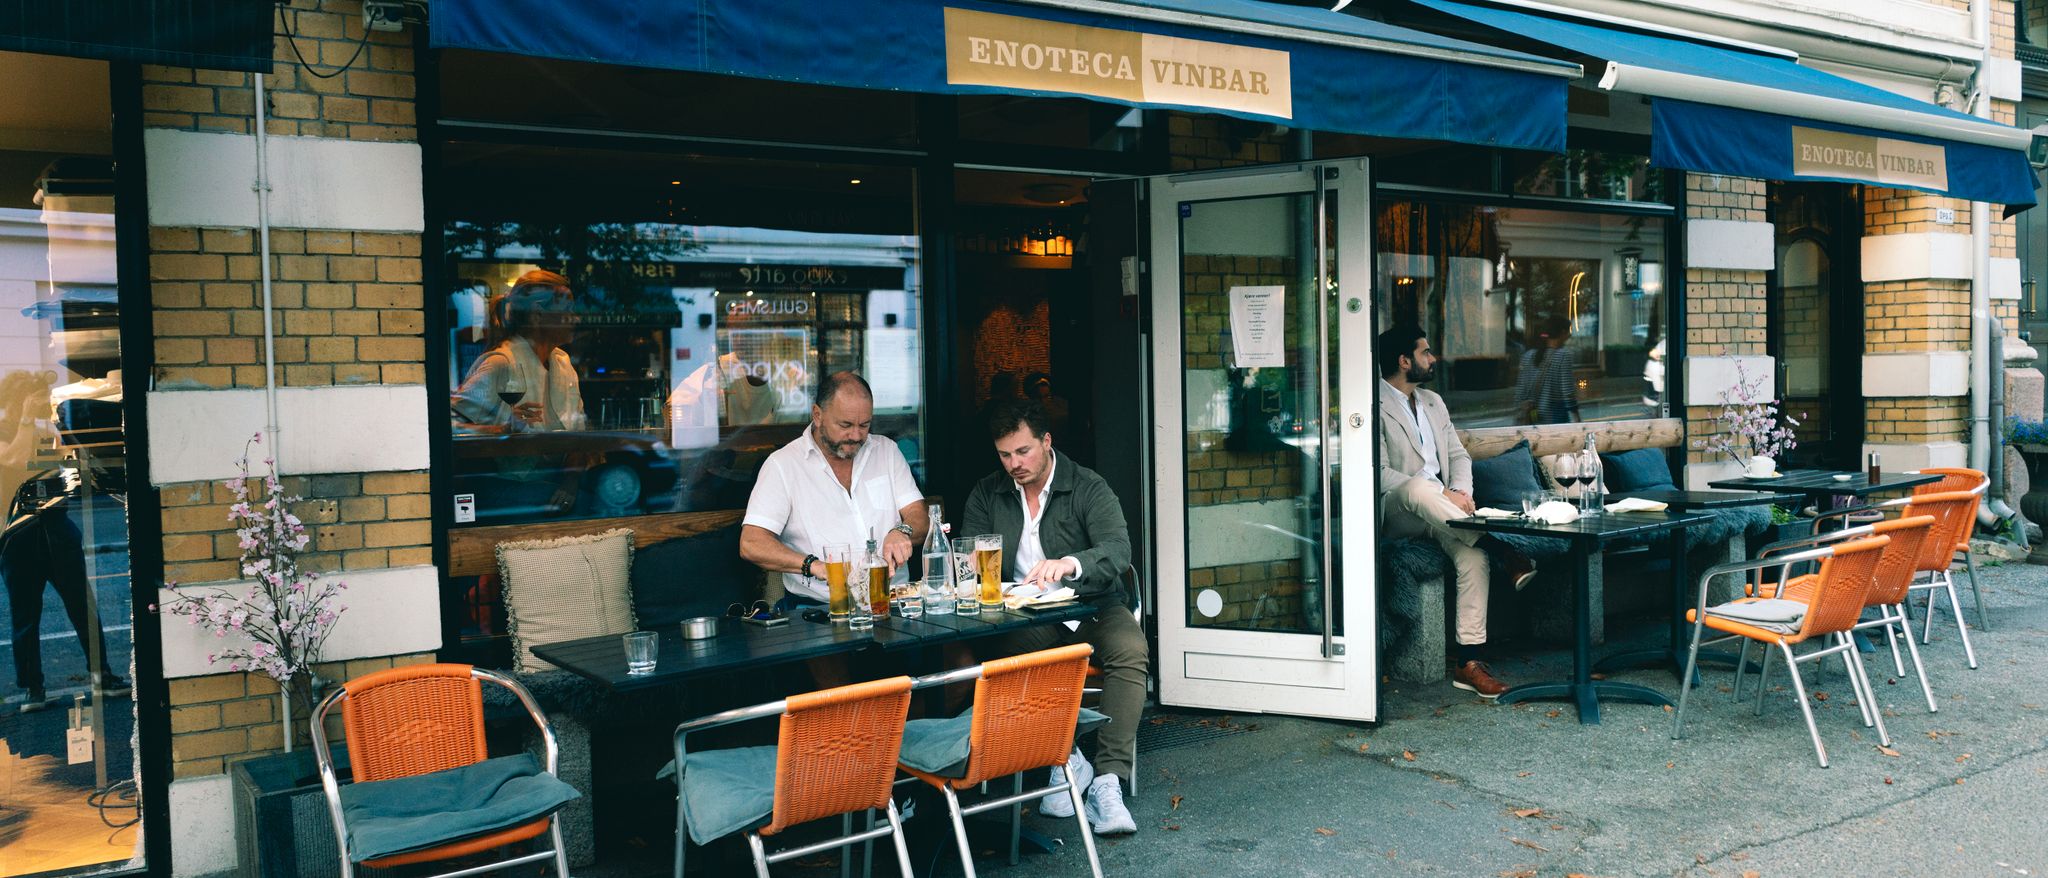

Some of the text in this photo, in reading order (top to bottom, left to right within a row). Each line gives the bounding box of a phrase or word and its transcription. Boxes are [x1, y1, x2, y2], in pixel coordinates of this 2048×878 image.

[968, 36, 1270, 96] ENOTECA VINBAR
[1801, 143, 1936, 176] ENOTECA VINBAR
